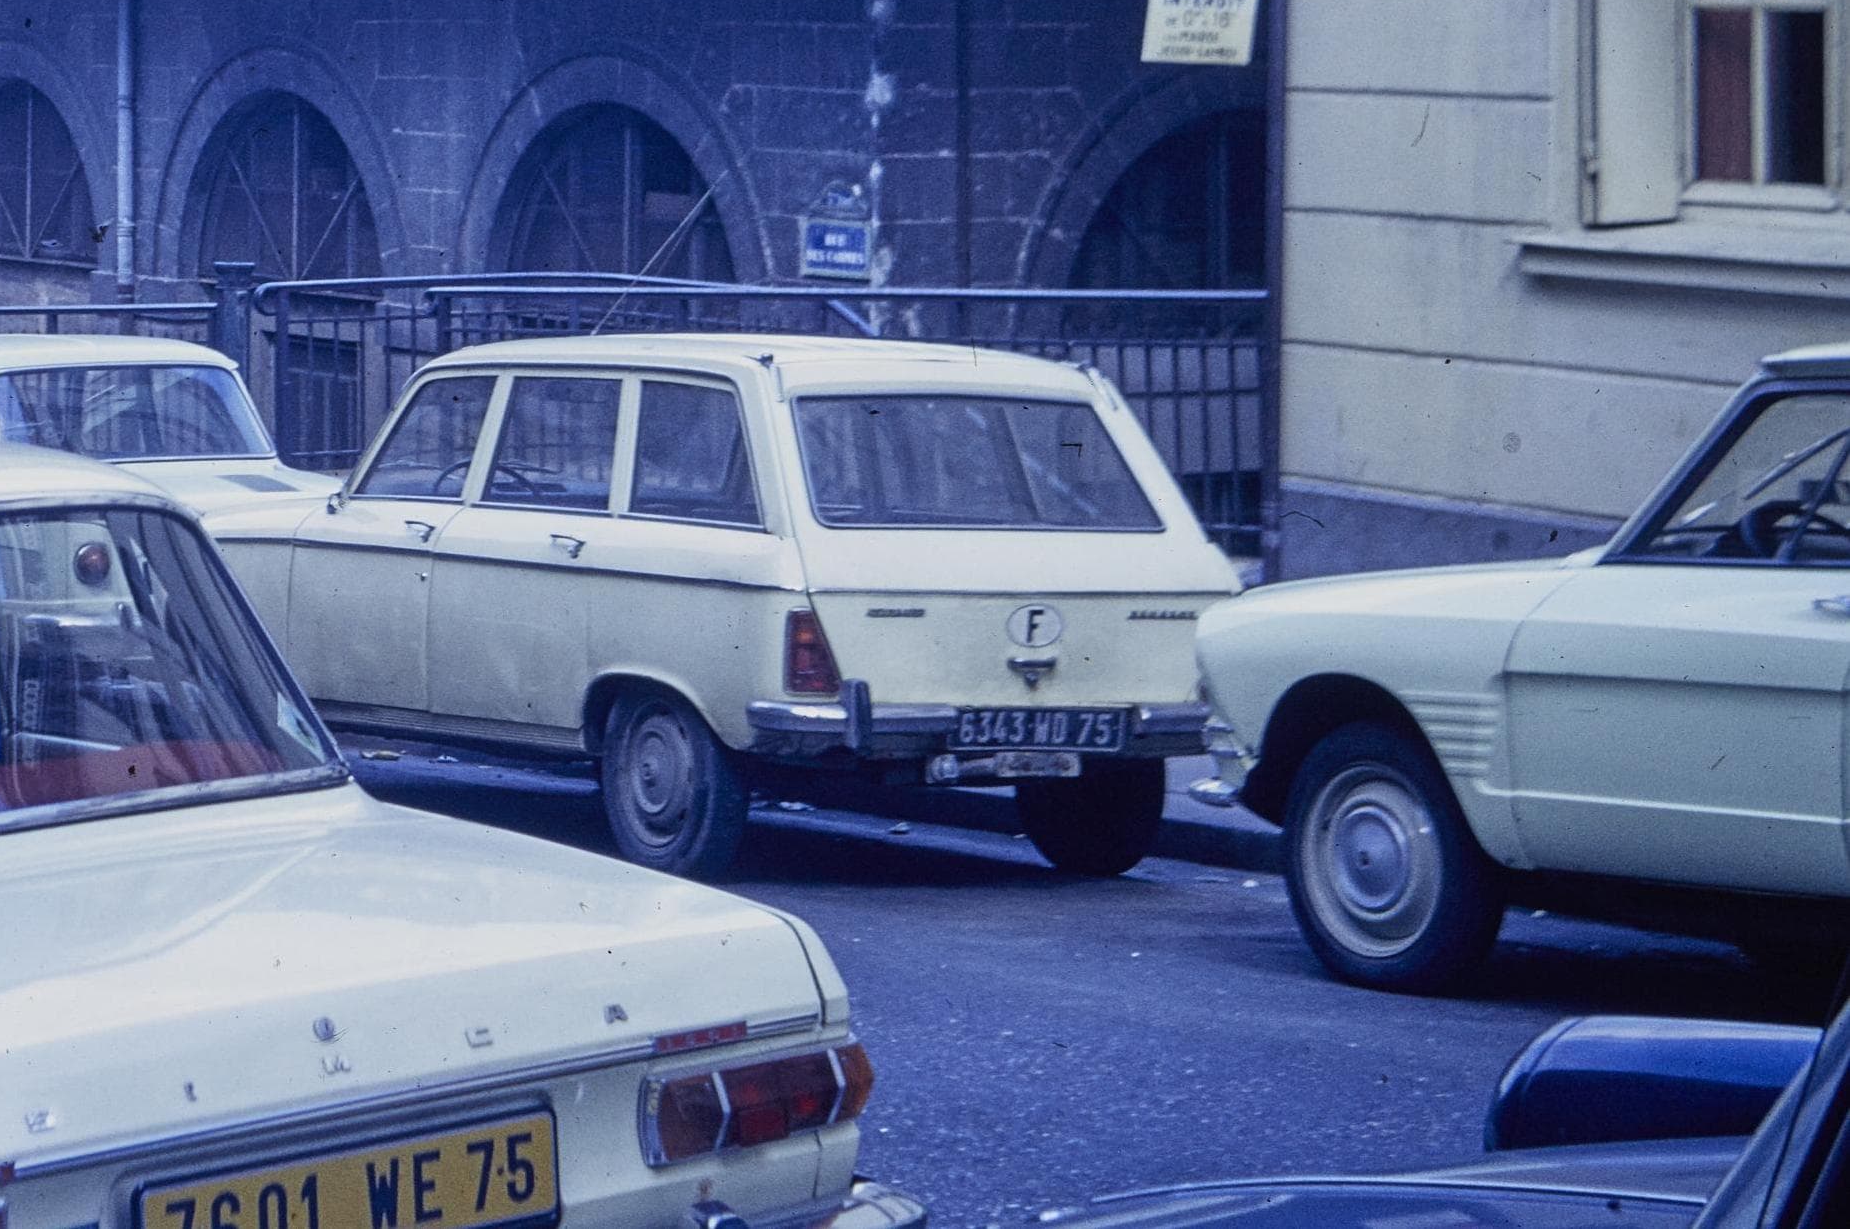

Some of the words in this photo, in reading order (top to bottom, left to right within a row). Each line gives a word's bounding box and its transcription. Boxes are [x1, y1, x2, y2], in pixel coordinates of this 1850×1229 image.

[1026, 609, 1045, 643] F
[959, 711, 1027, 744] 6343
[1075, 713, 1114, 745] 75
[365, 1150, 443, 1229] WE
[466, 1132, 535, 1213] 75
